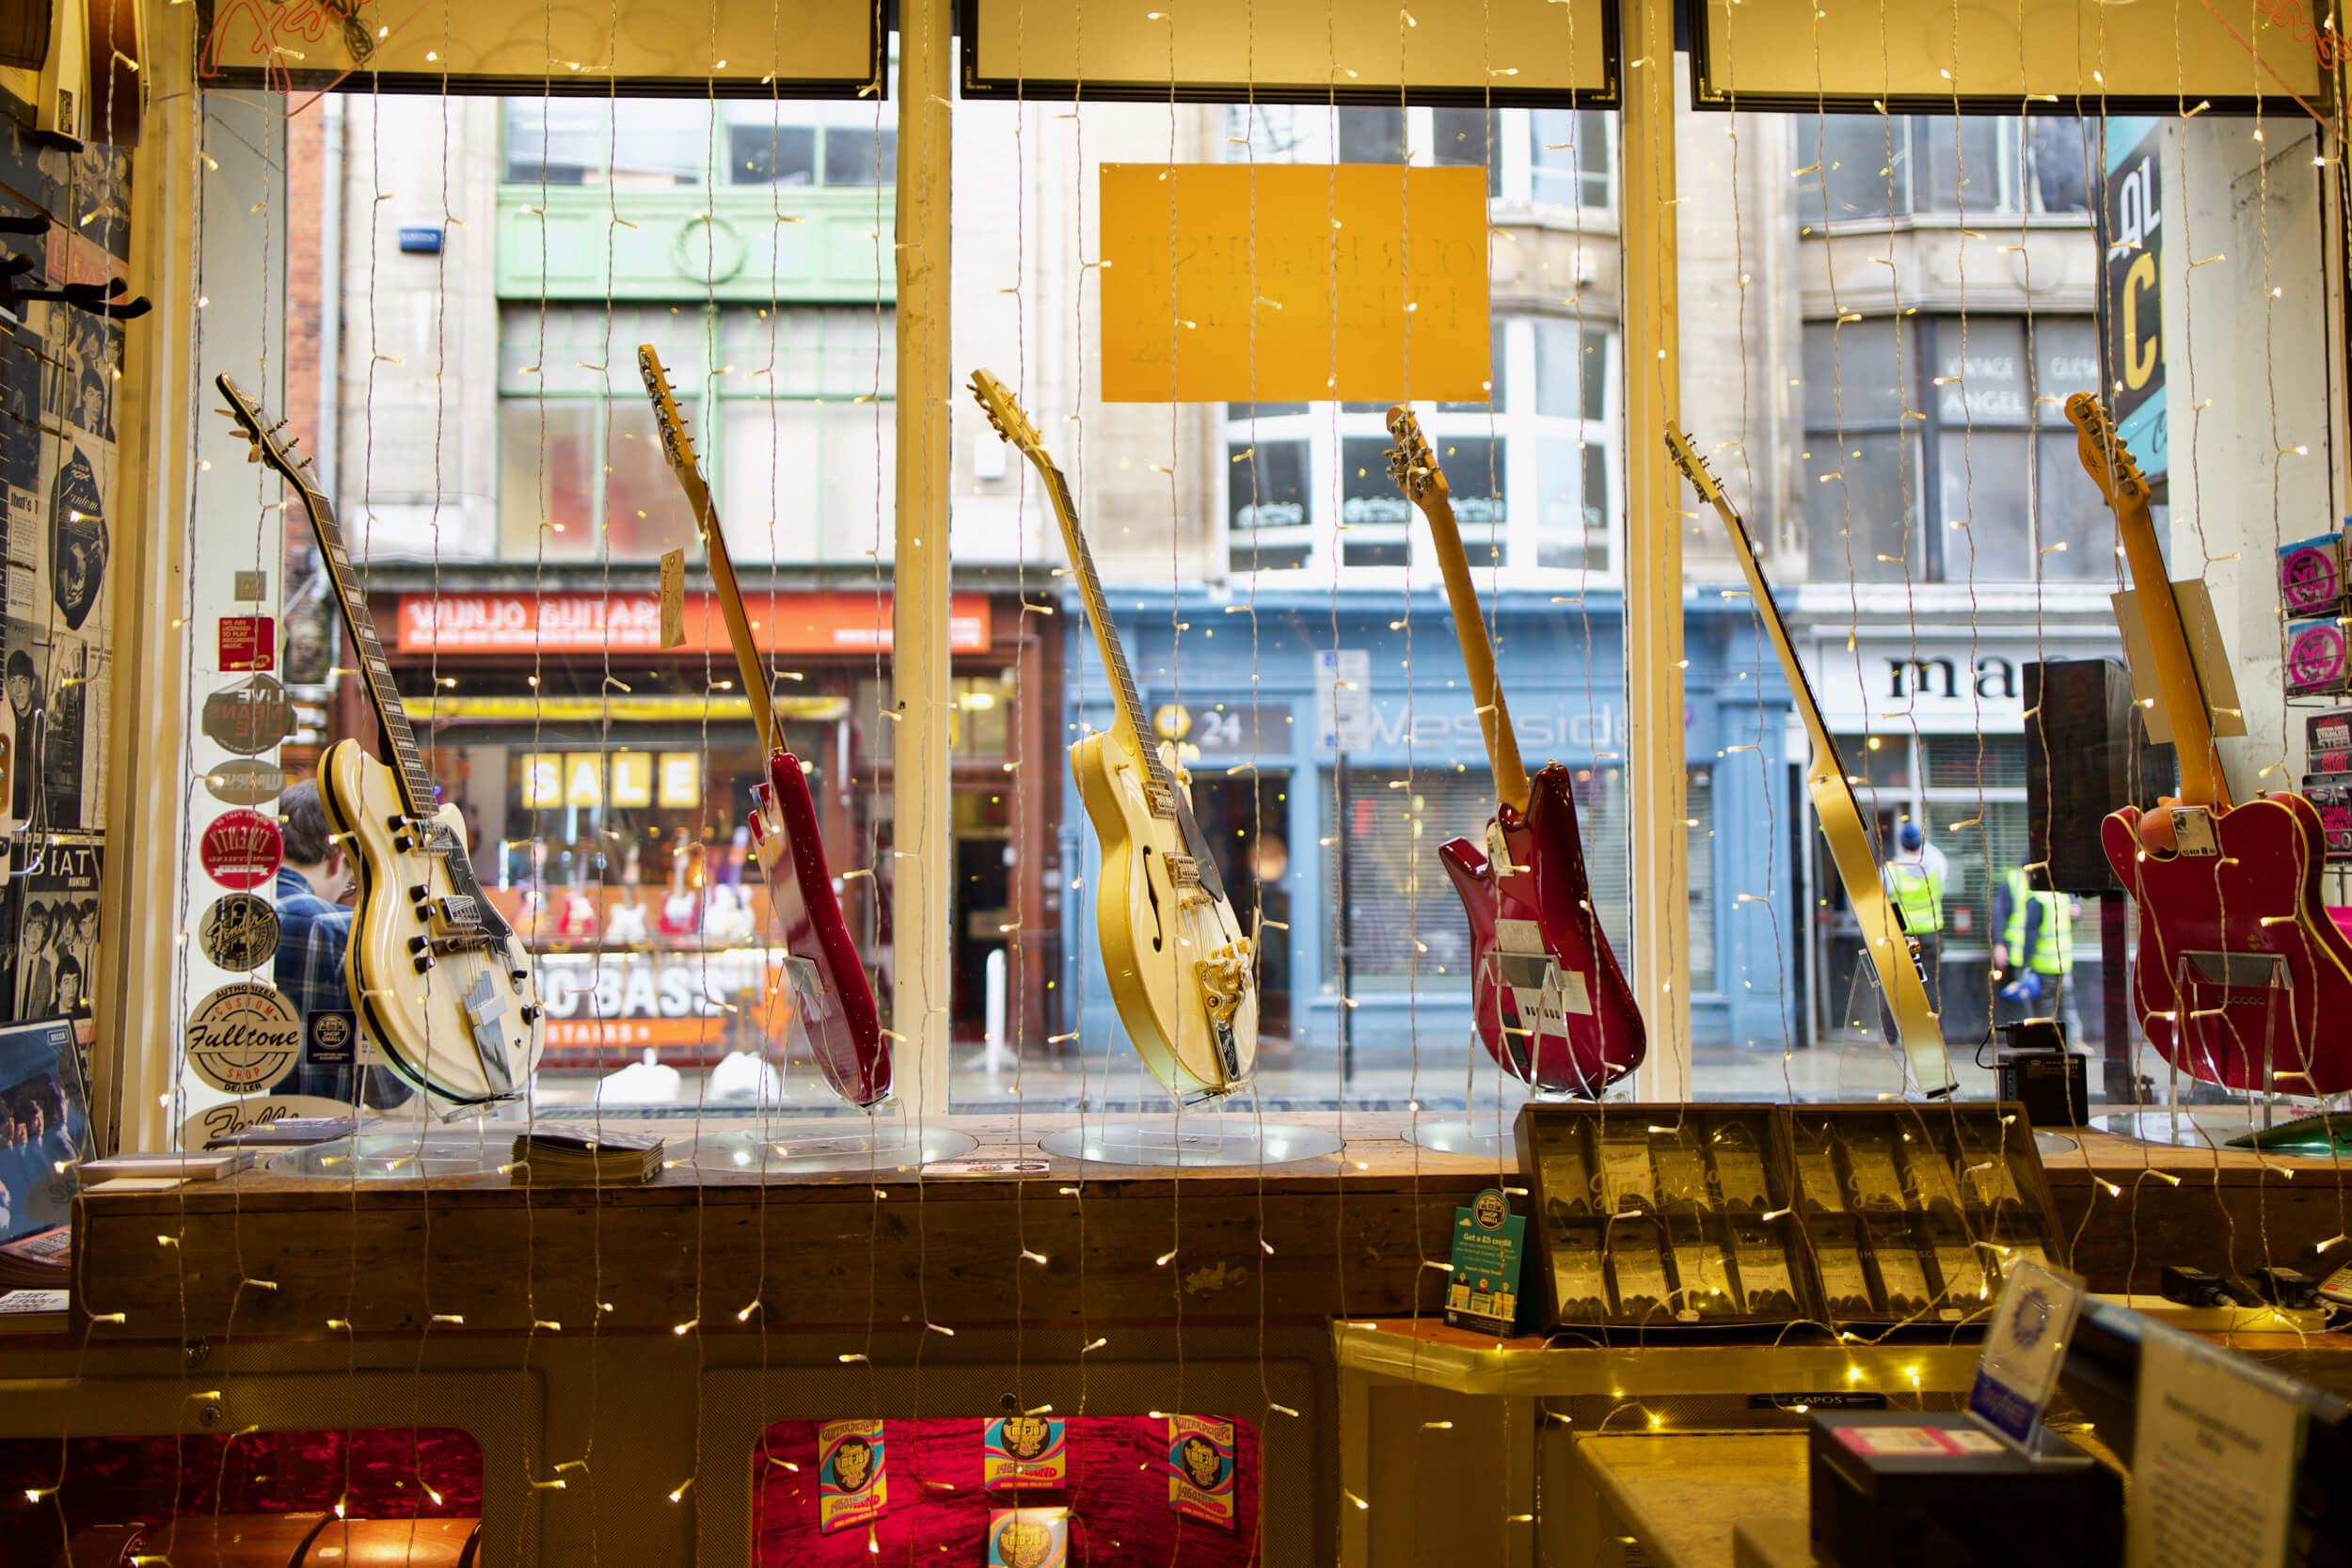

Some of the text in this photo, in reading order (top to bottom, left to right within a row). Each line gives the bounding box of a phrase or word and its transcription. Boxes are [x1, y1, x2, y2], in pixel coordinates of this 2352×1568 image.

[2123, 250, 2165, 391] C
[1944, 391, 2026, 415] ANGEL
[1200, 711, 1241, 746] 24
[527, 761, 693, 801] SALE
[205, 911, 275, 953] Fender
[588, 967, 728, 1019] BASS
[215, 997, 275, 1016] CUSTOM
[188, 1024, 300, 1050] Fulltone
[227, 1067, 261, 1079] SHOP
[224, 1084, 262, 1092] DEALER
[1464, 1232, 1475, 1243] Get
[1792, 1396, 1843, 1404] CAPOS
